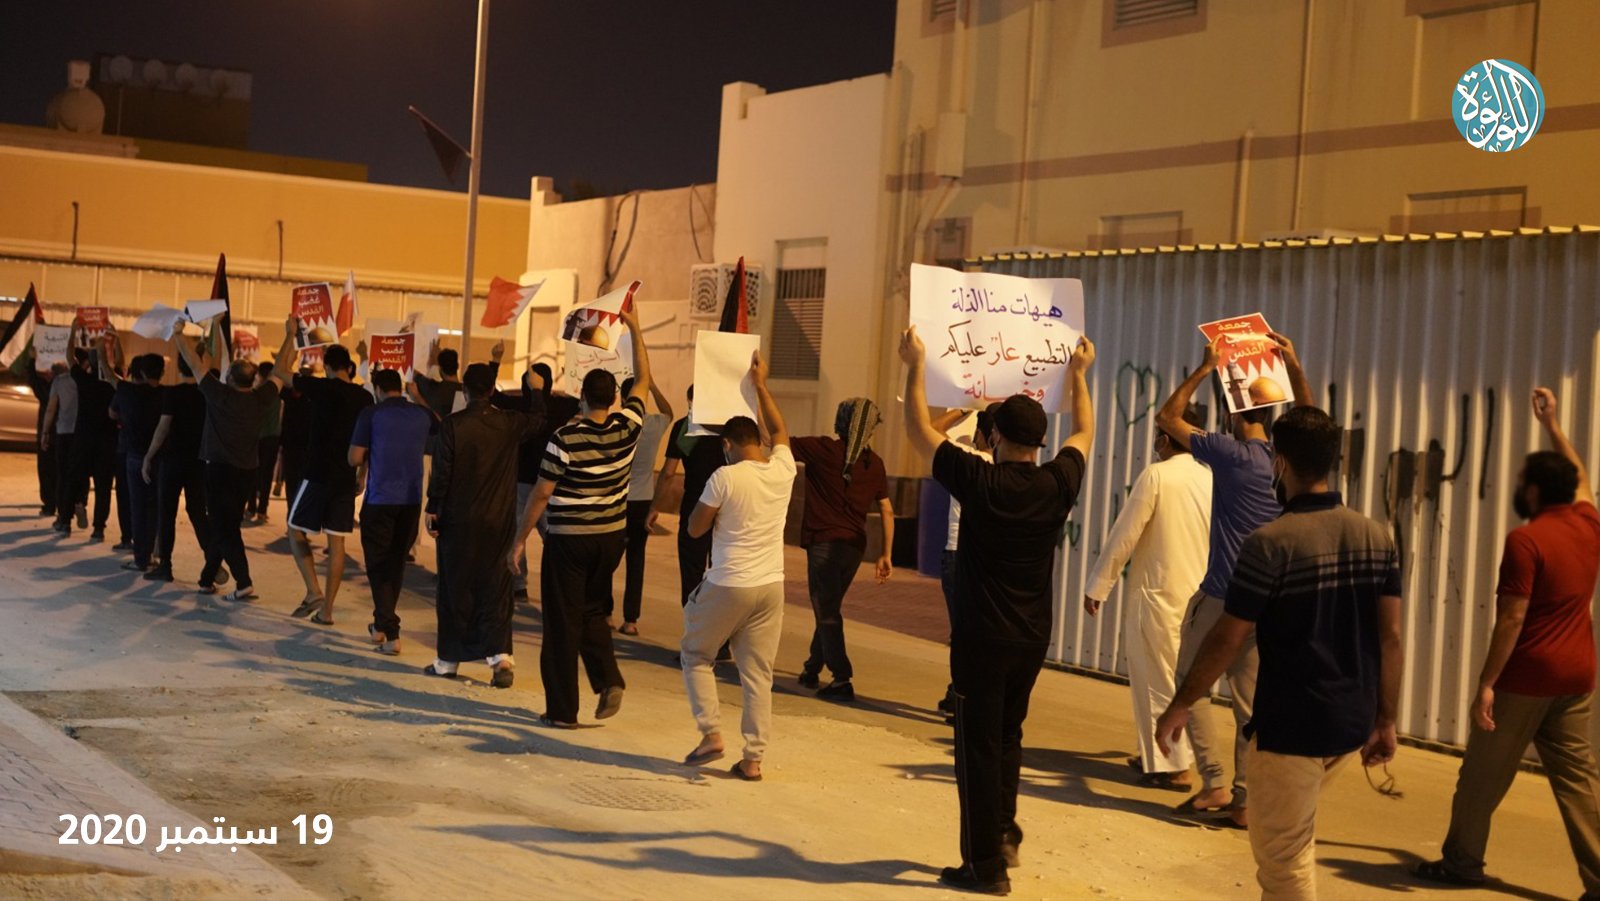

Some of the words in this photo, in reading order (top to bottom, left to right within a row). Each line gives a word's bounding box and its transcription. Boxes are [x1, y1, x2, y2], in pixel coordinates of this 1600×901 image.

[952, 287, 984, 313] الذلة
[984, 288, 1007, 313] منا
[1010, 293, 1063, 327] هيهات
[1216, 320, 1252, 331] جمعة
[940, 320, 986, 364] عليكم
[1228, 341, 1266, 363] القدس
[1023, 339, 1073, 377] التطبيع
